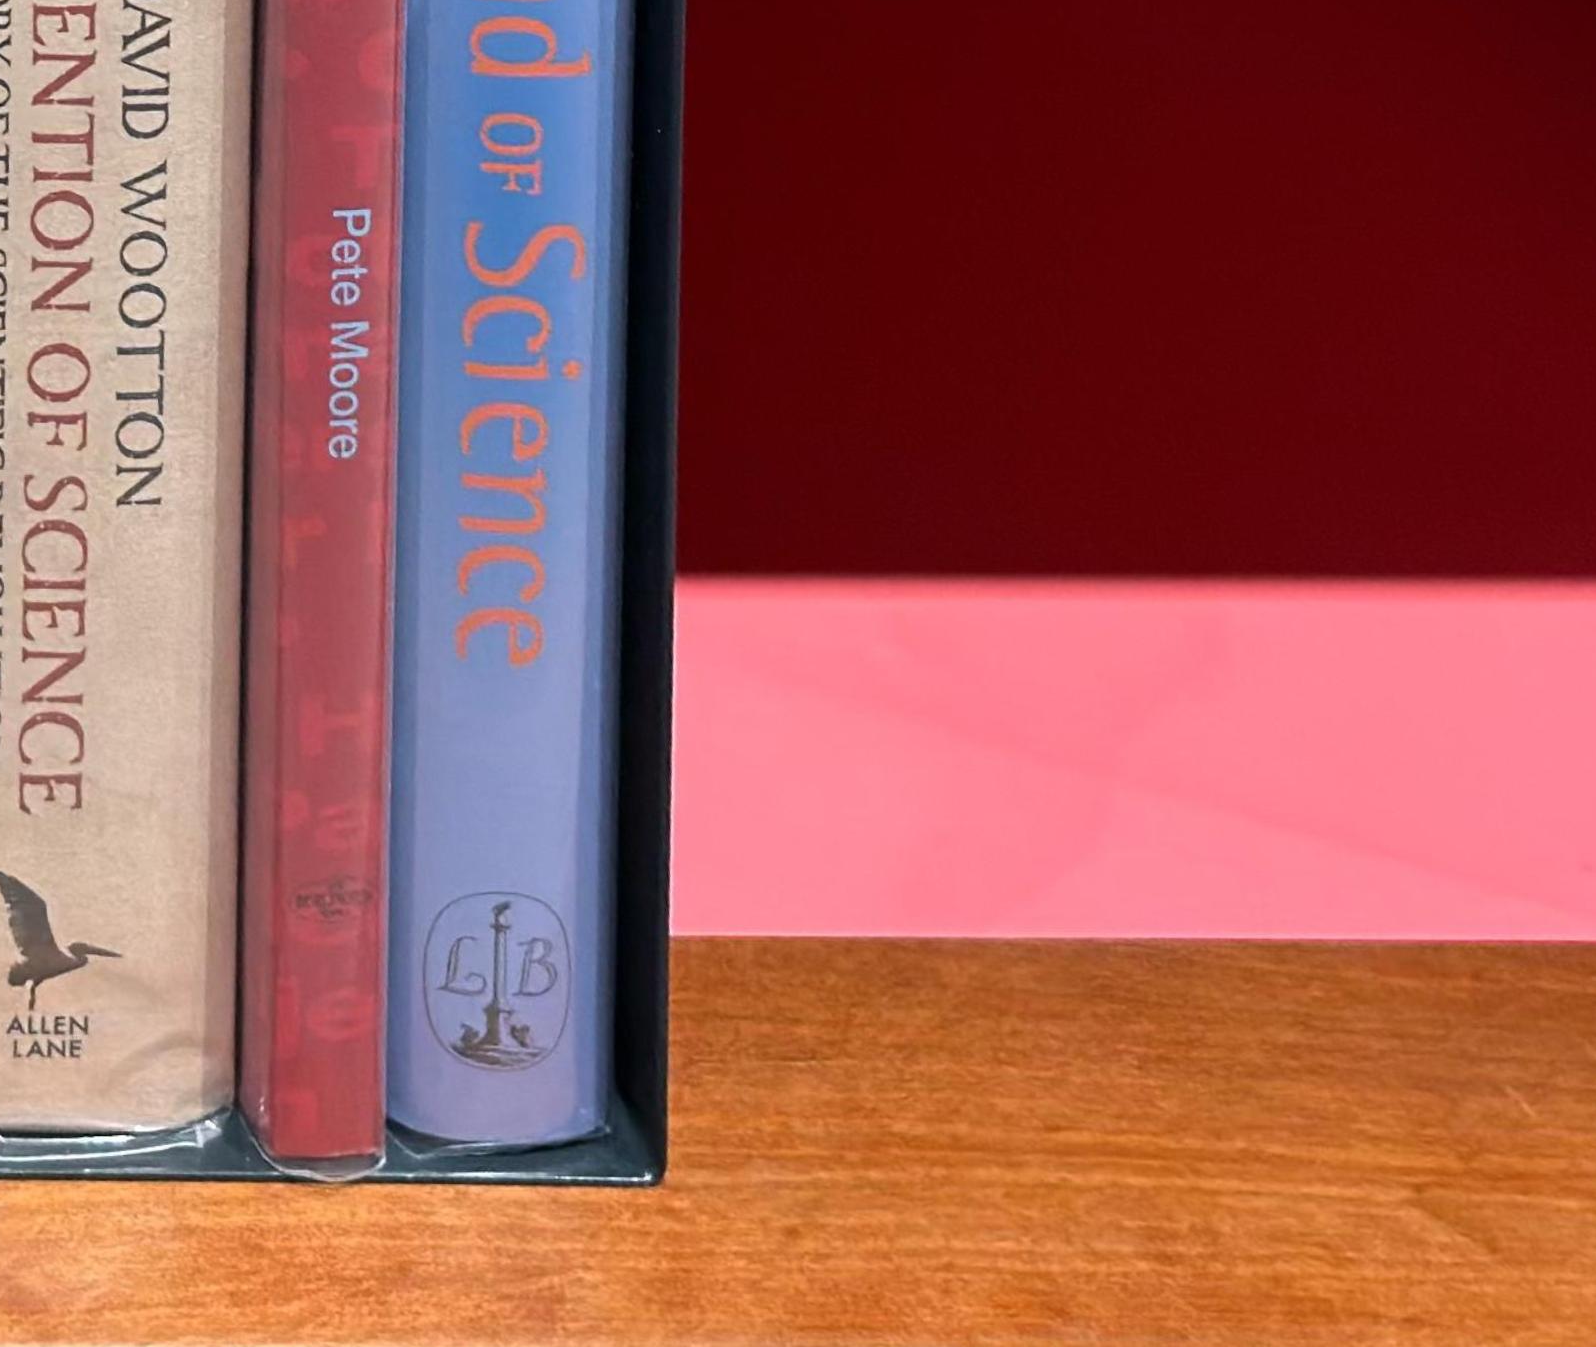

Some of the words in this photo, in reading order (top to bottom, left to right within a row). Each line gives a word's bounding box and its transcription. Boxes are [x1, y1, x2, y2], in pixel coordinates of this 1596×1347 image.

[479, 111, 544, 195] OF
[331, 208, 372, 306] Pete
[114, 160, 168, 507] WOOTTON
[27, 343, 91, 452] OF
[327, 320, 370, 460] Moore
[455, 221, 587, 668] Science
[19, 474, 88, 815] SCIENCE
[6, 1015, 89, 1035] ALLEN
[13, 1040, 82, 1058] LANE
